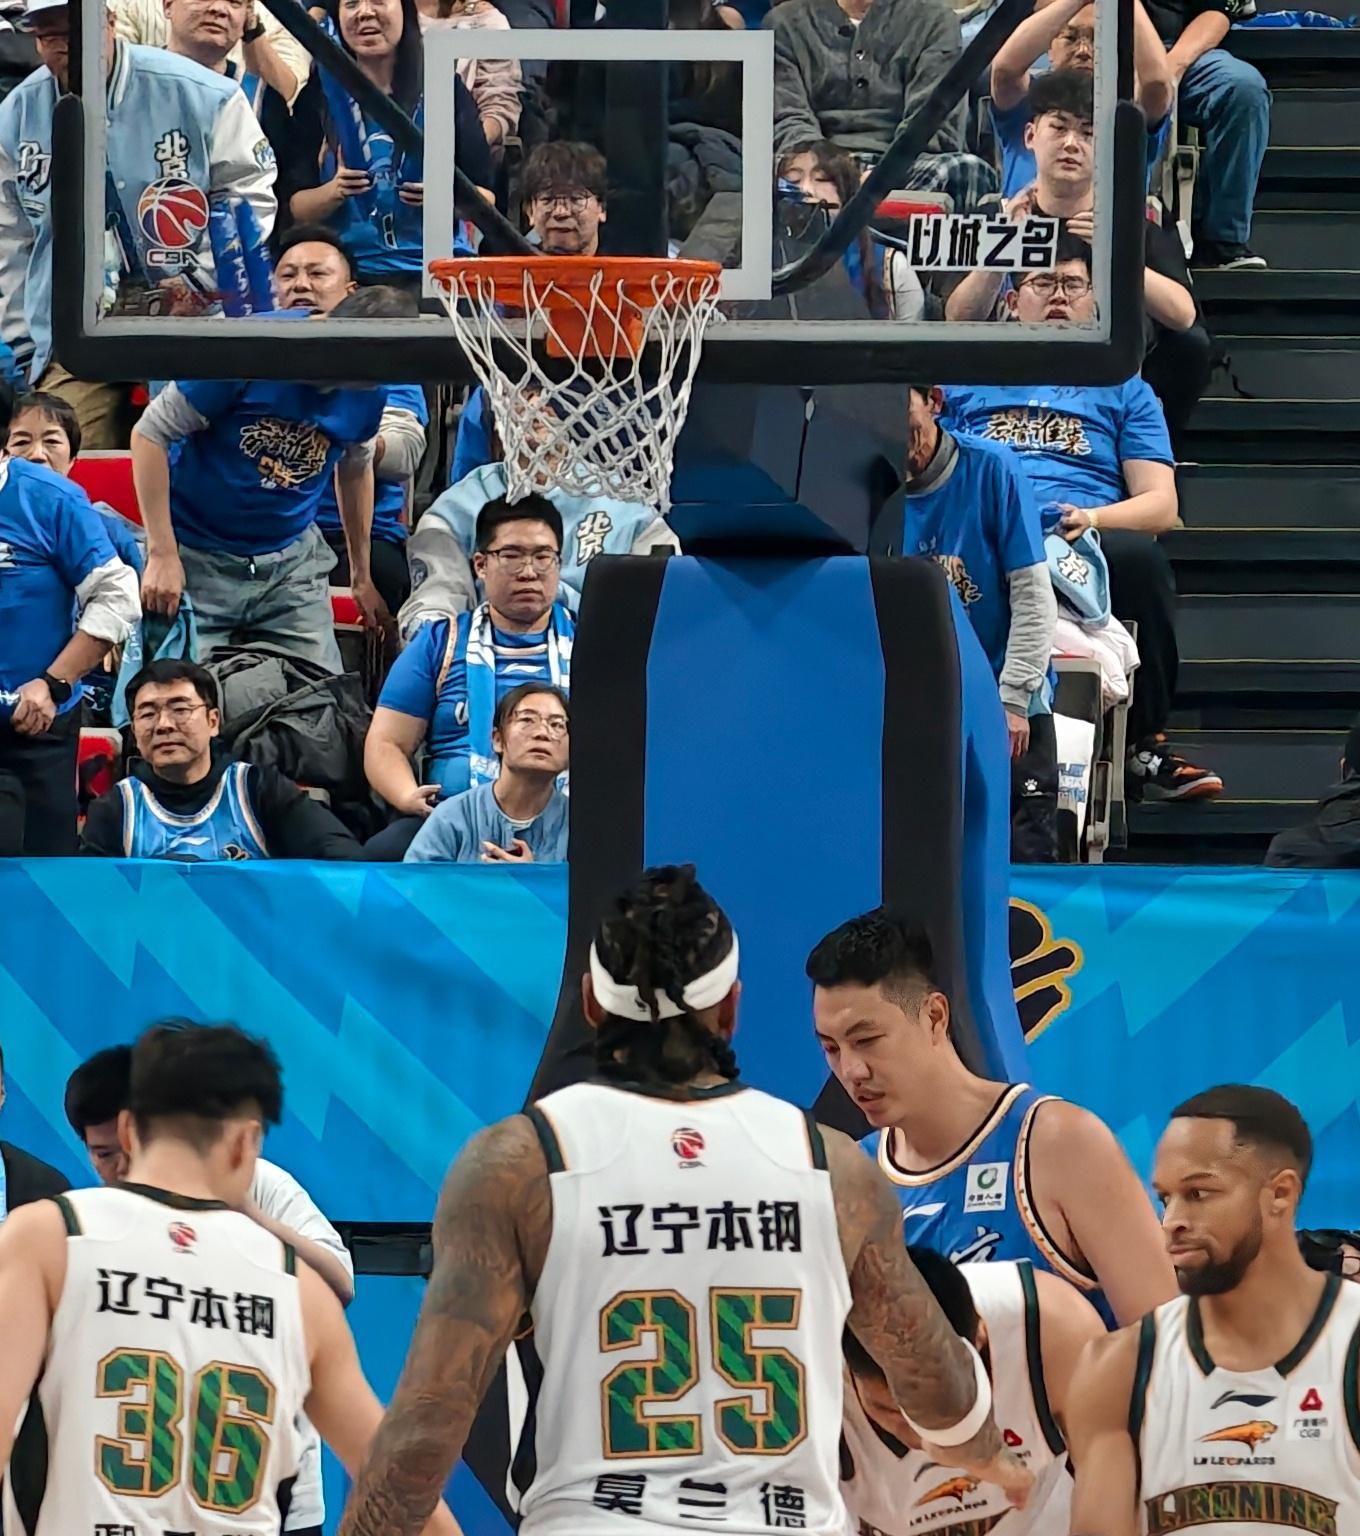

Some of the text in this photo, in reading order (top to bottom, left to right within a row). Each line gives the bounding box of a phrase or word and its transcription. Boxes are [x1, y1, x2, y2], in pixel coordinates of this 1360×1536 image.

[909, 216, 1057, 269] 以城之名
[599, 1200, 803, 1256] 辽宁本钢
[96, 1268, 276, 1339] 辽宁本钢
[599, 1286, 808, 1460] 25
[94, 1346, 277, 1515] 36
